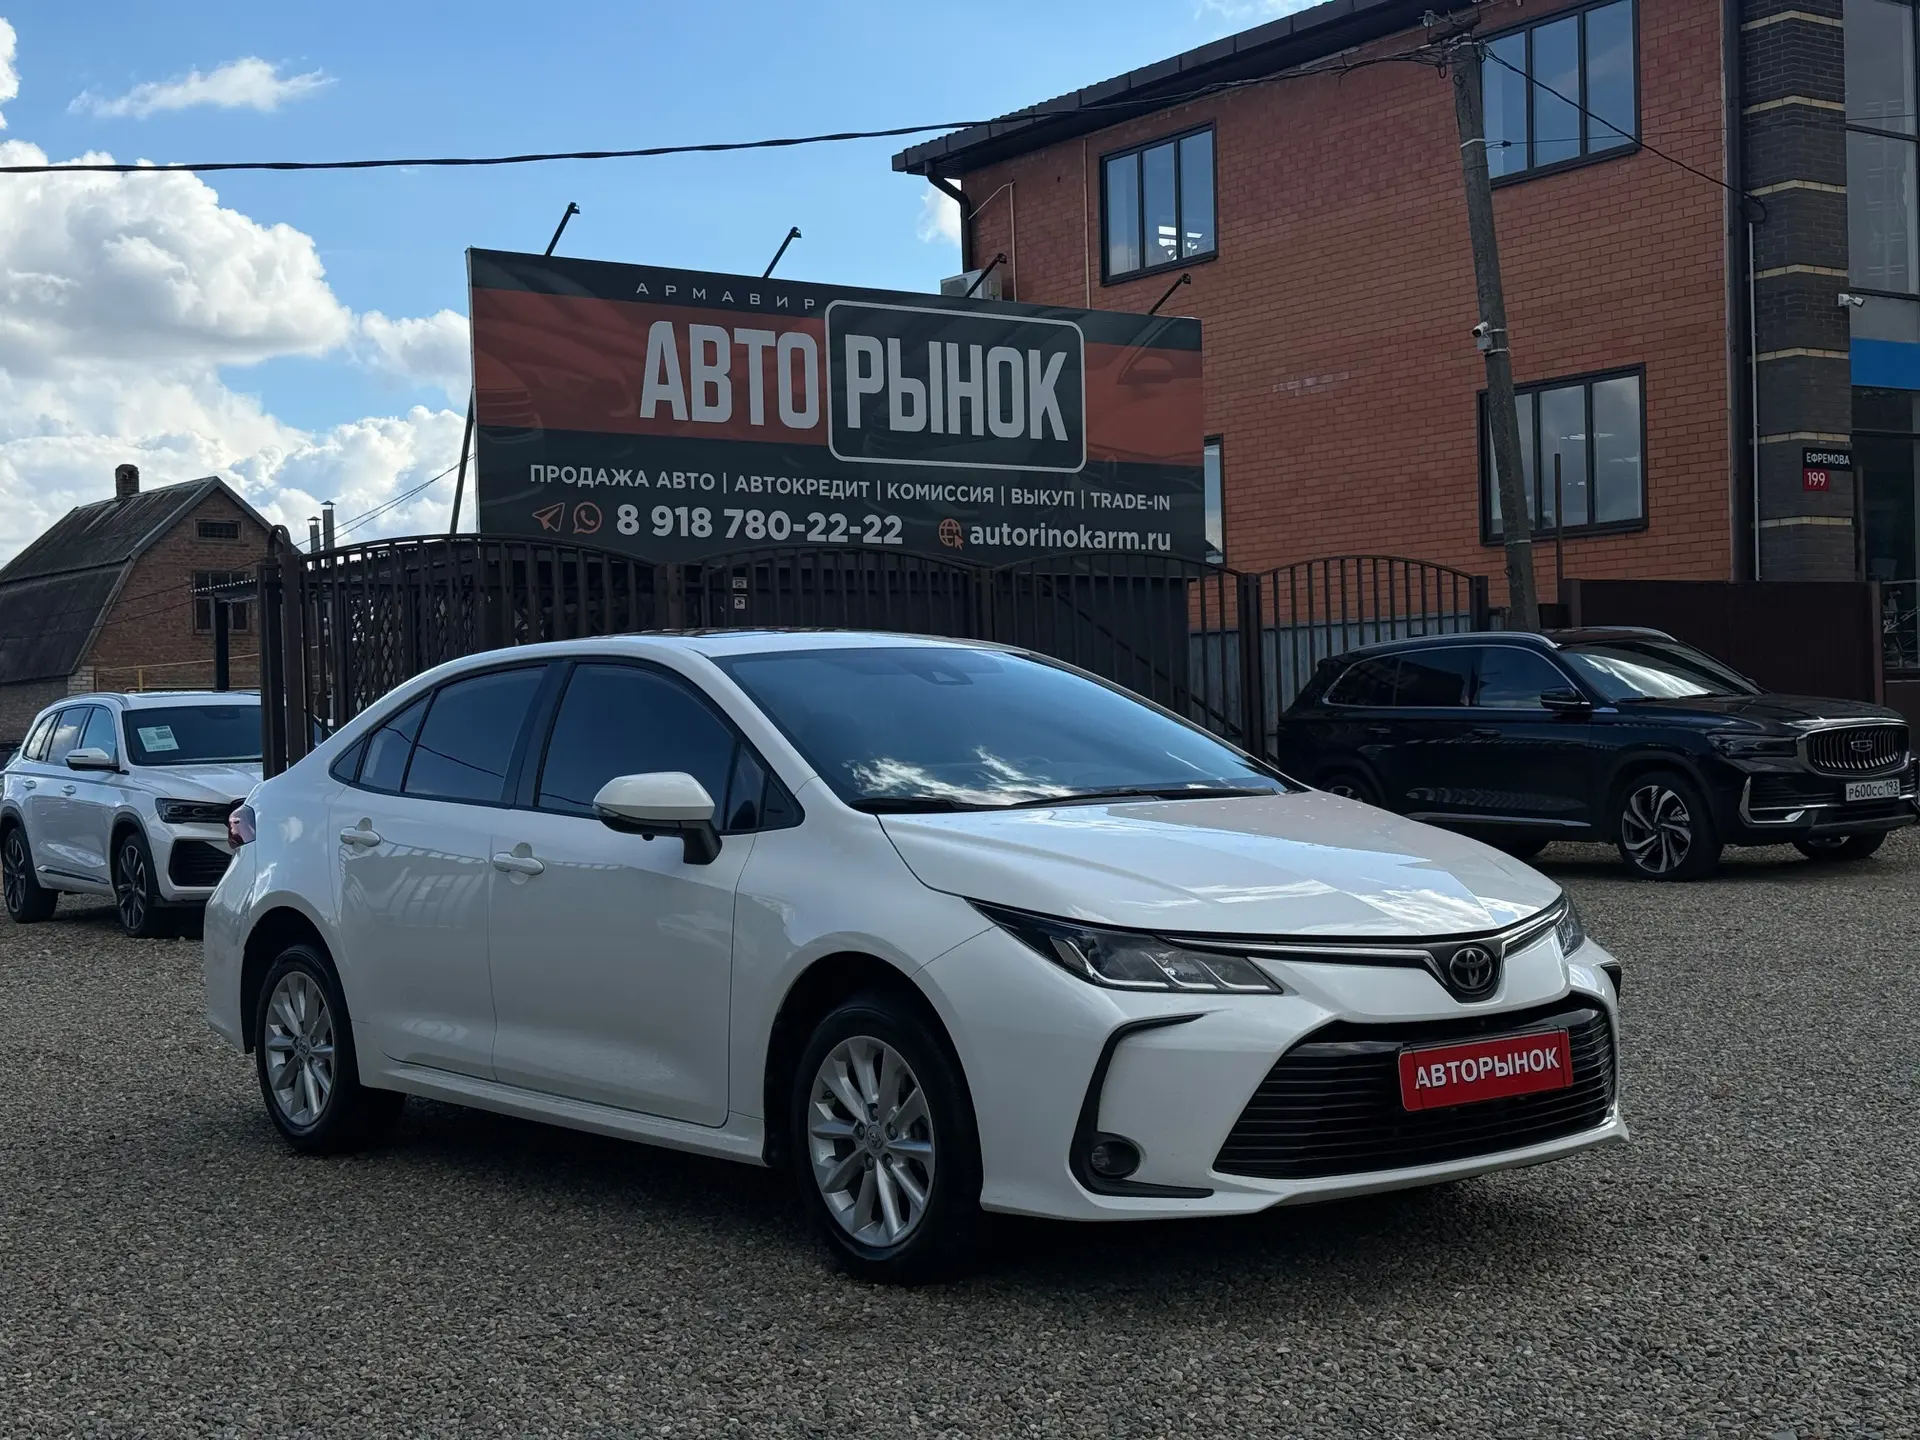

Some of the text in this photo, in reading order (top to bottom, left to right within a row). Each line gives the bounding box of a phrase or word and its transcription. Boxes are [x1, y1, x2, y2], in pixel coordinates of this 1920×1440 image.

[635, 282, 817, 310] АРМАВИР
[639, 320, 1069, 441] АВТО РЫНОК
[1806, 452, 1851, 465] ЕФРЕМОВА
[1807, 471, 1826, 487] 199
[529, 464, 1170, 511] ПРОДАЖА АВТО АВТОКРЕДИТ КОМИССИЯ ВЫКУП TRADE-IN
[616, 504, 1171, 551] 8 918 780-22-22 autorinokarm.ru
[1415, 1047, 1561, 1090] АВТОРЫНОК
